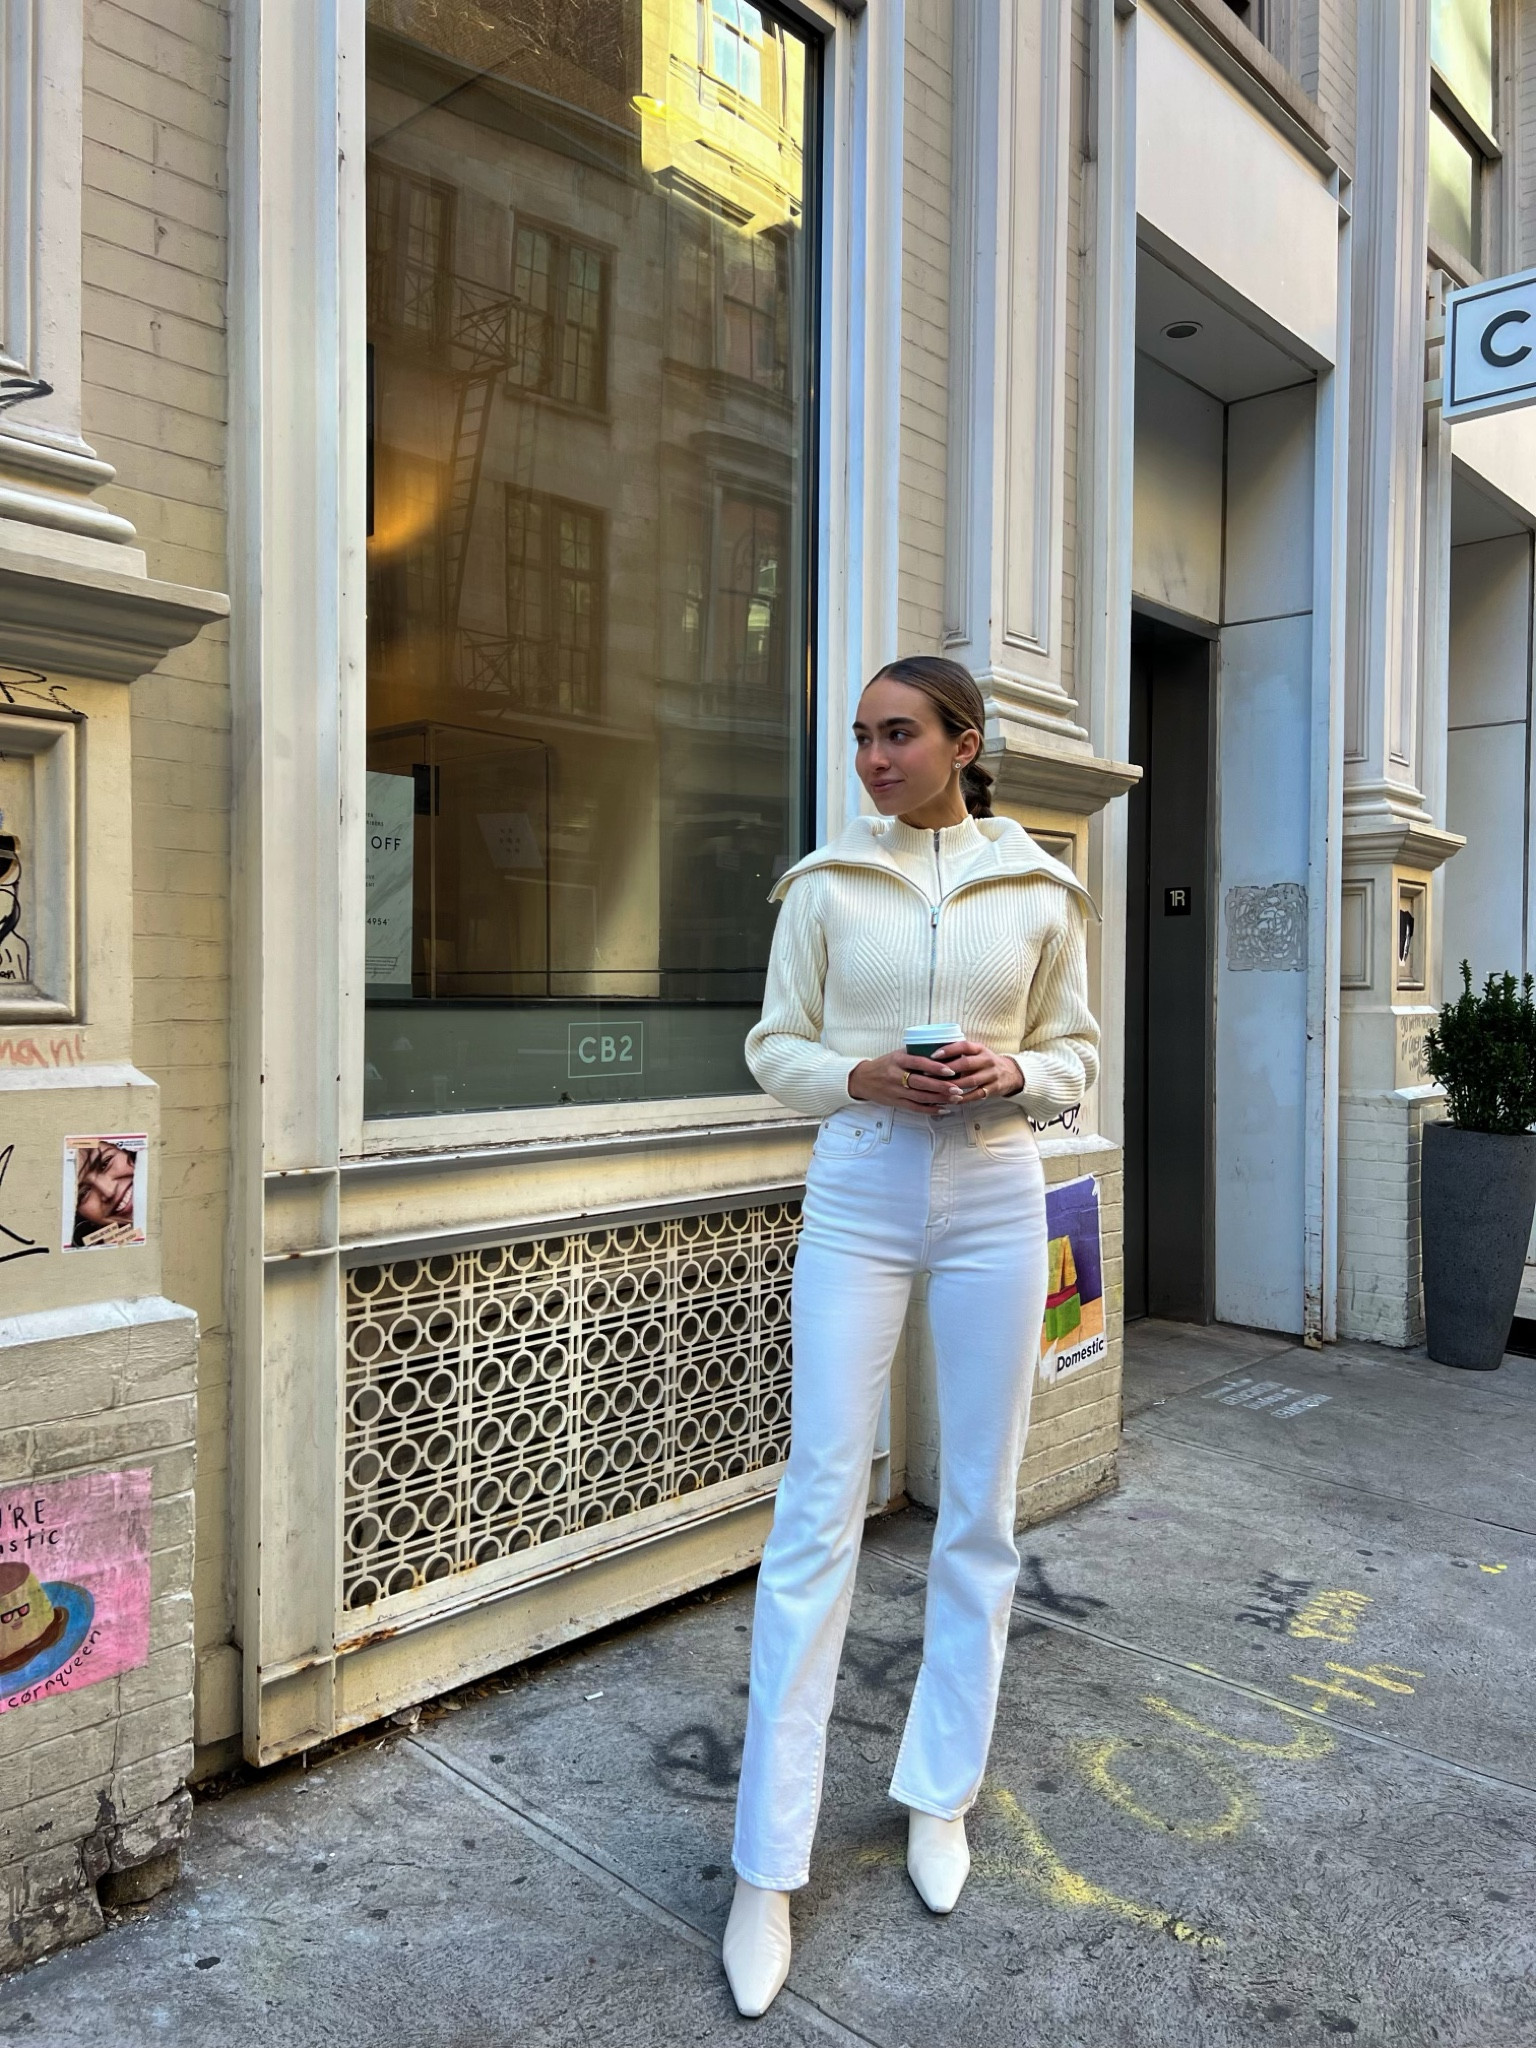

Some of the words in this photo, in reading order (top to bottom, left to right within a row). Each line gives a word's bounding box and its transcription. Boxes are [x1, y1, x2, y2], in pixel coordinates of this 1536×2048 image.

[1480, 310, 1533, 368] C
[371, 836, 401, 851] OFF
[1169, 889, 1186, 907] 1R
[578, 1035, 633, 1064] CB2
[1056, 1337, 1104, 1373] Domestic
